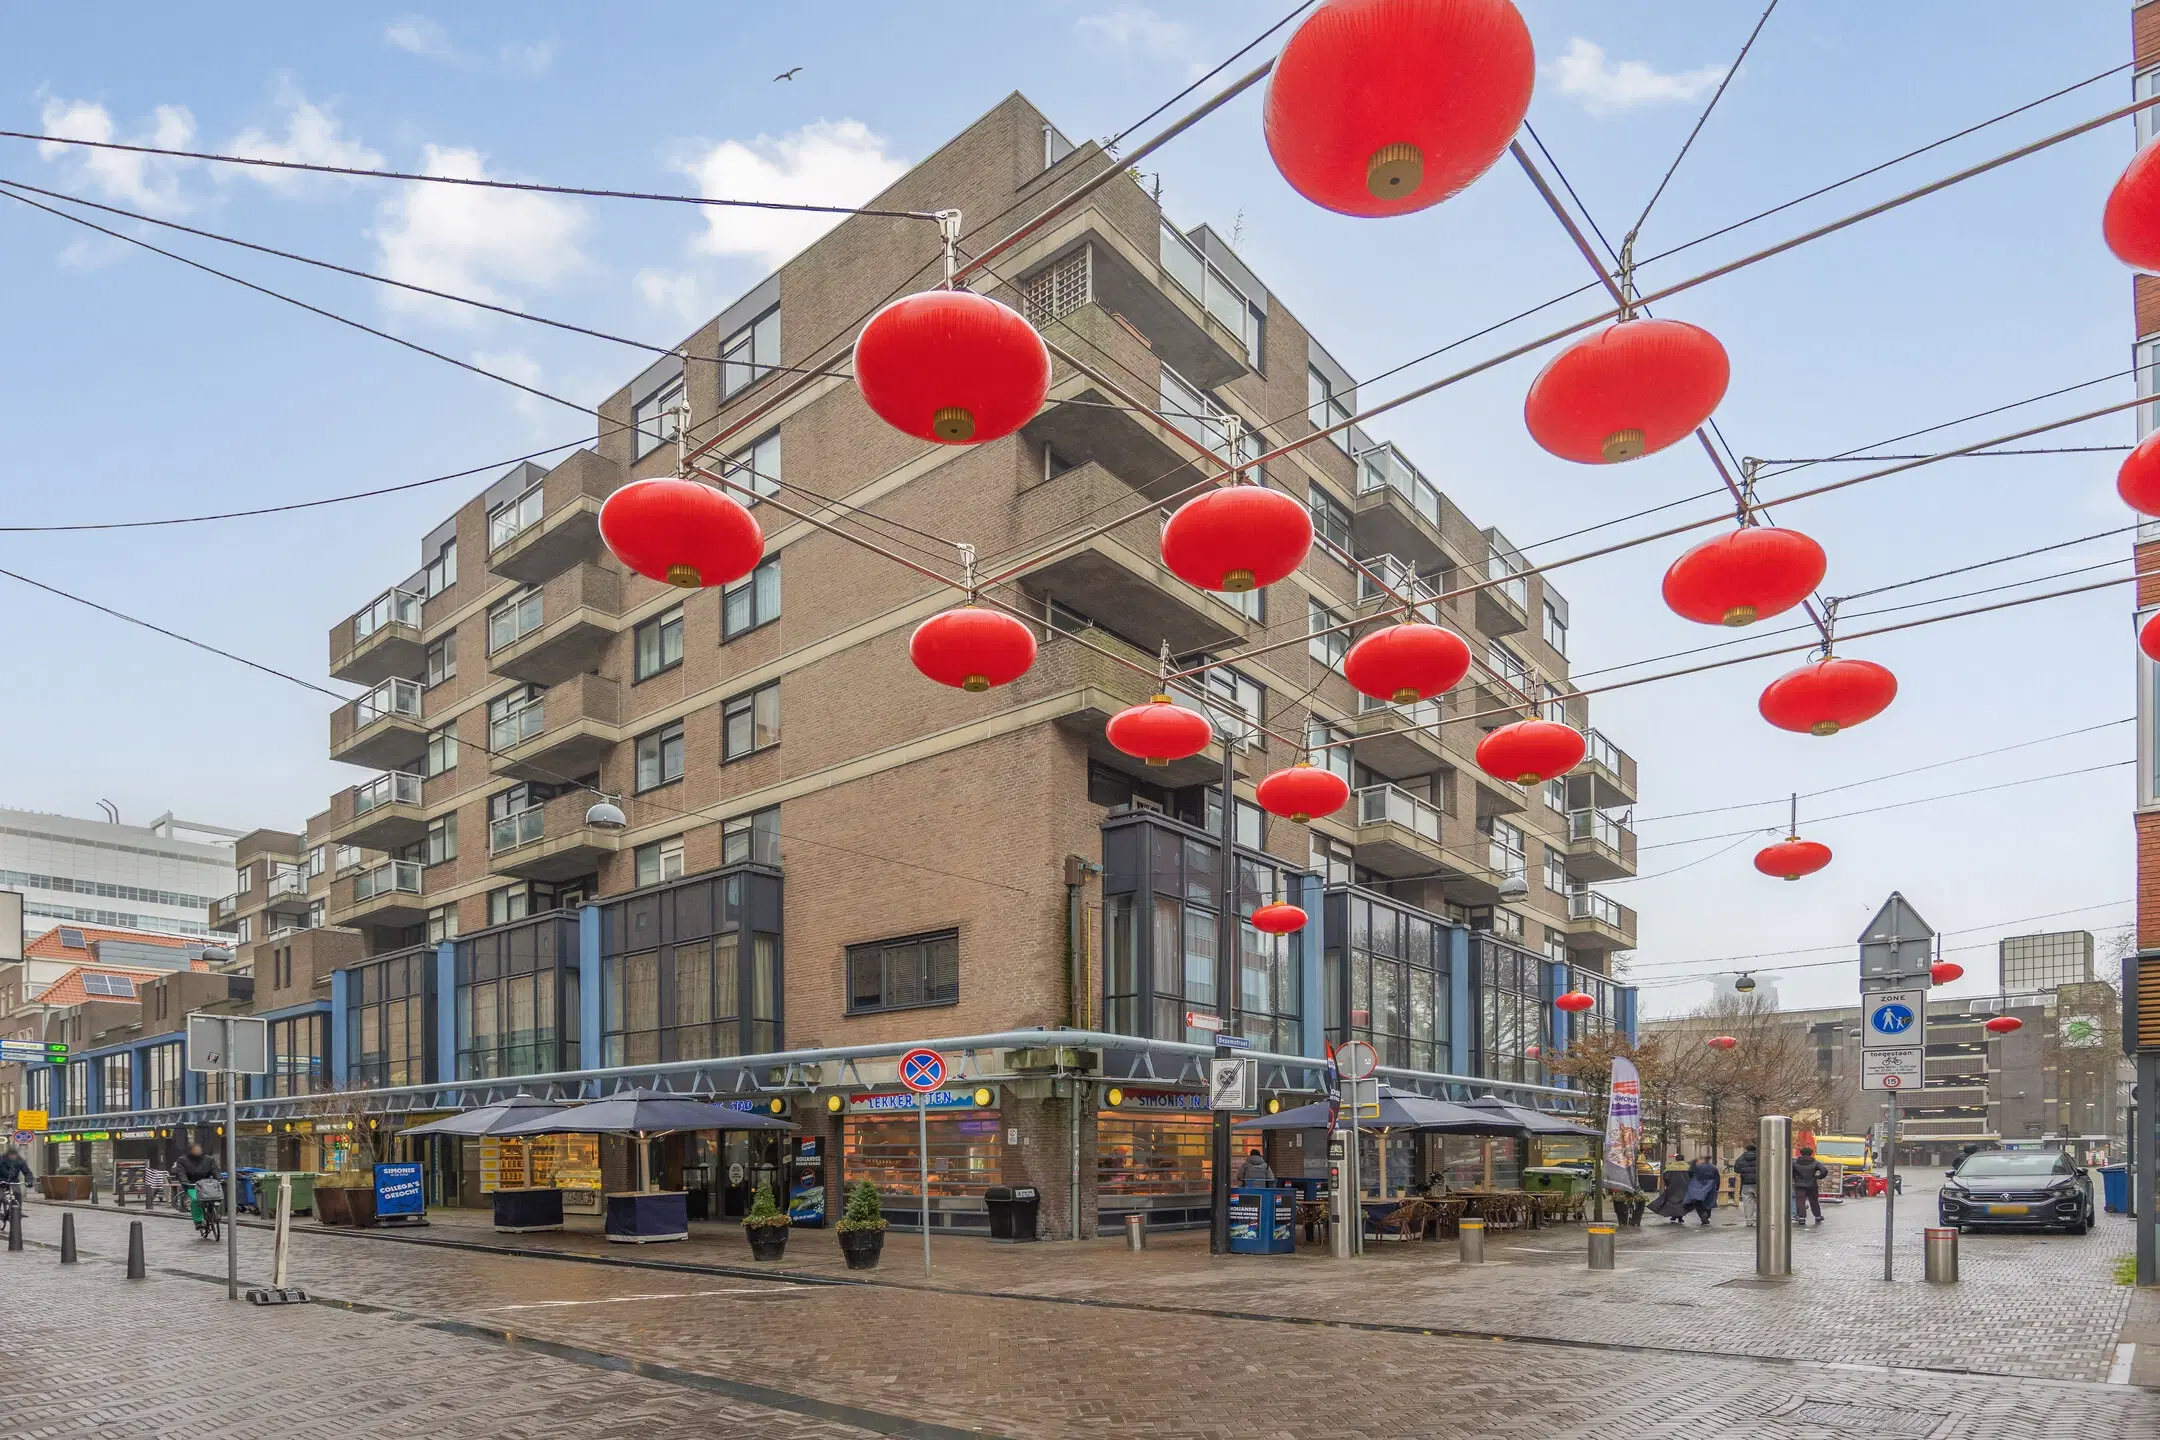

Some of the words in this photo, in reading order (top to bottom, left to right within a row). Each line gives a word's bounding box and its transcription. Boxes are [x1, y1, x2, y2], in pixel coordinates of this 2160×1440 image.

[1219, 1037, 1248, 1047] Bezemstraat
[729, 1100, 753, 1111] STAD
[869, 1093, 913, 1109] LEKKER
[1140, 1095, 1185, 1107] SIMONIS
[1189, 1095, 1200, 1108] IN
[380, 1181, 420, 1194] COLLEGA'S
[384, 1187, 419, 1200] GEZOCHT
